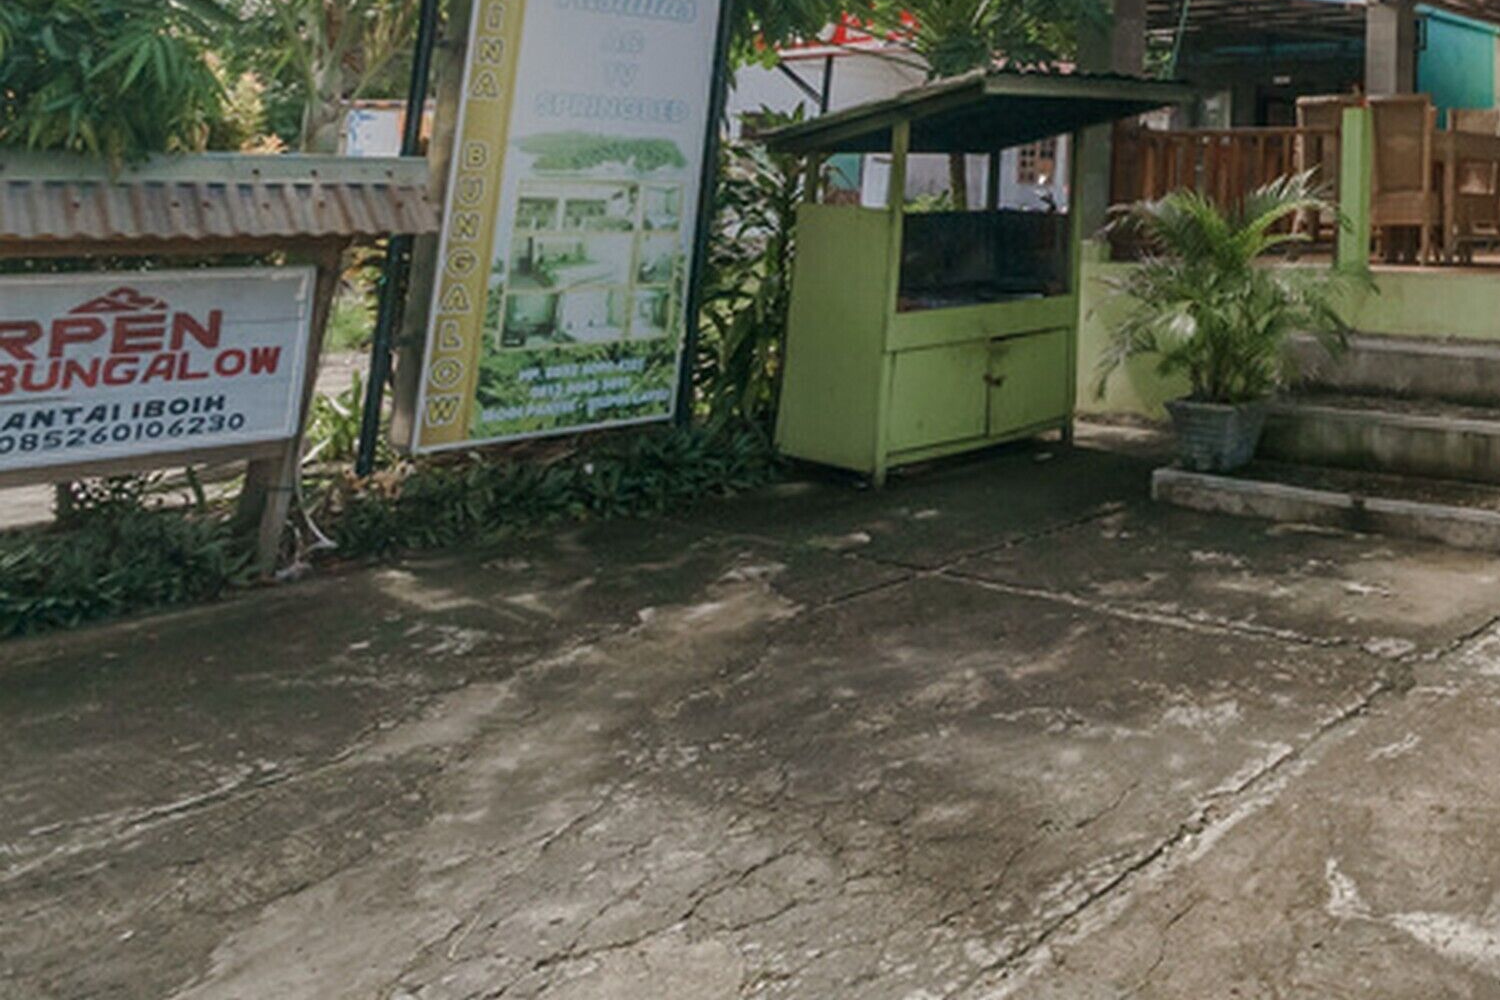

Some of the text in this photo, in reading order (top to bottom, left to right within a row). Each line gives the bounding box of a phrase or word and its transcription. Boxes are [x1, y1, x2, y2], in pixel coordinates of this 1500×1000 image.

[424, 141, 488, 428] BUNGALOW
[0, 310, 222, 361] RPEN
[0, 346, 281, 396] BUNGALOW
[0, 413, 244, 455] 085260106230
[2, 395, 225, 432] ANTAI IBOIH
